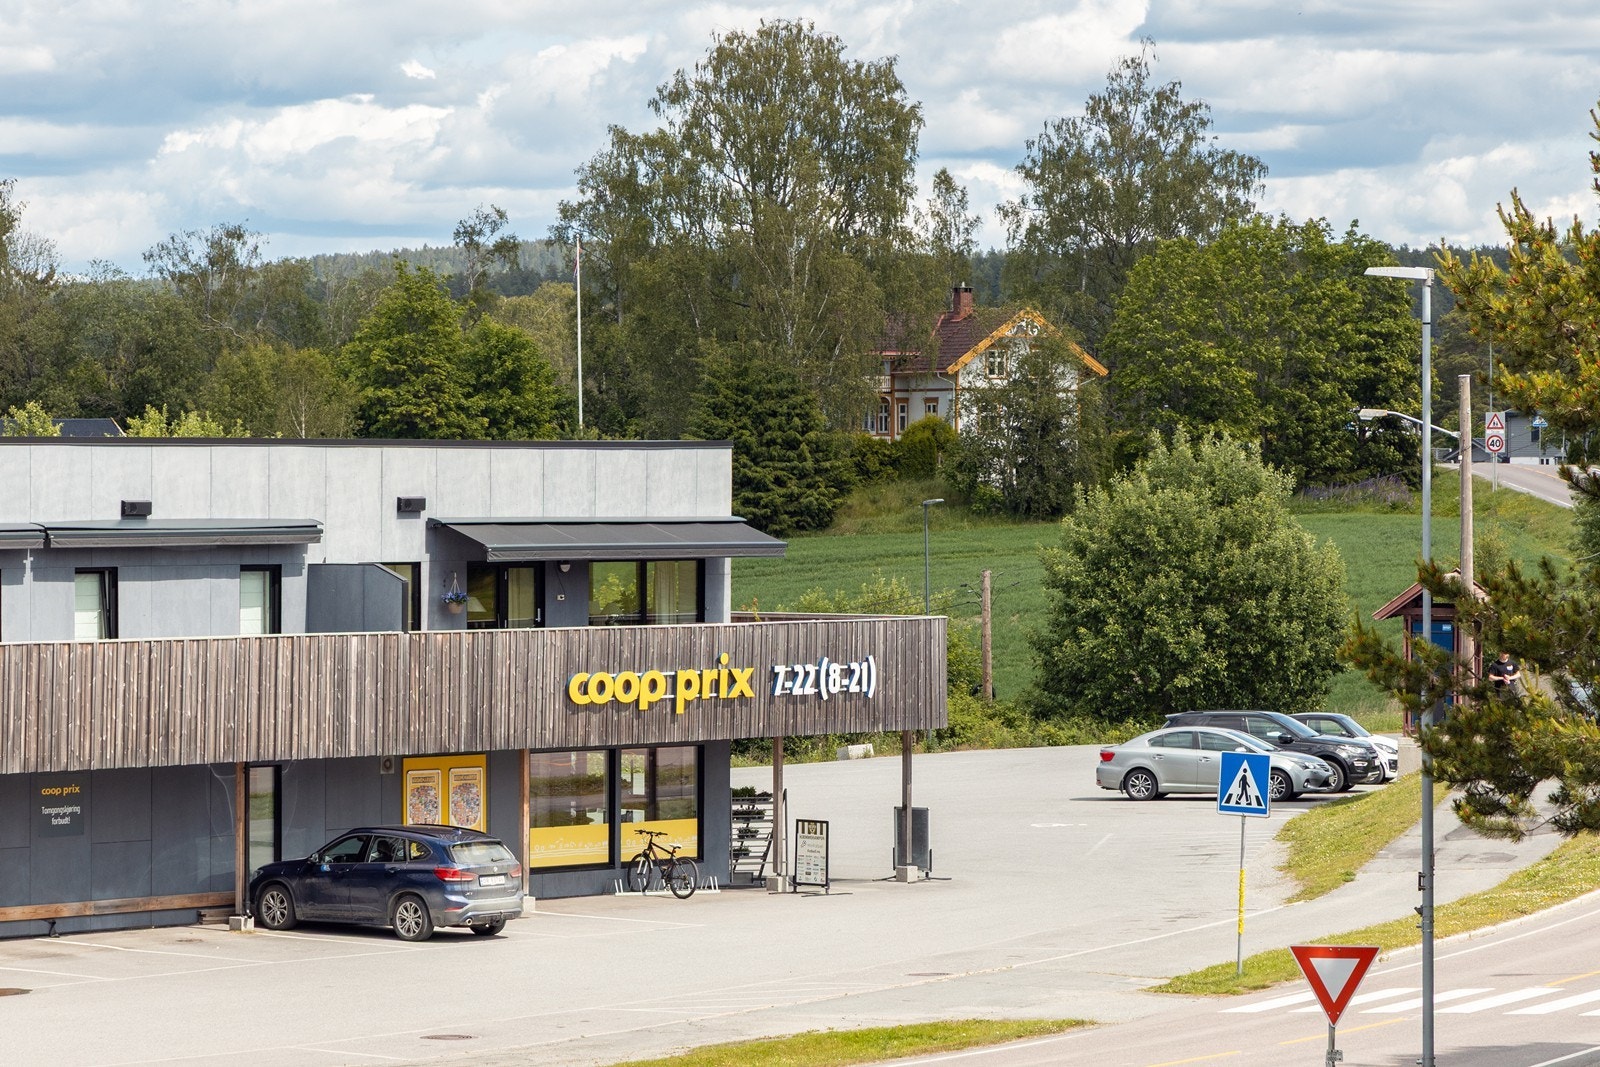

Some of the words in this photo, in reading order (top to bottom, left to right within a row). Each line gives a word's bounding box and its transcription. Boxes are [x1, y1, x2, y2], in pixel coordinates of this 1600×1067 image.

[1490, 439, 1501, 448] 40
[568, 670, 666, 710] coop
[676, 652, 755, 714] prix
[41, 788, 62, 796] coop
[63, 784, 80, 796] prix
